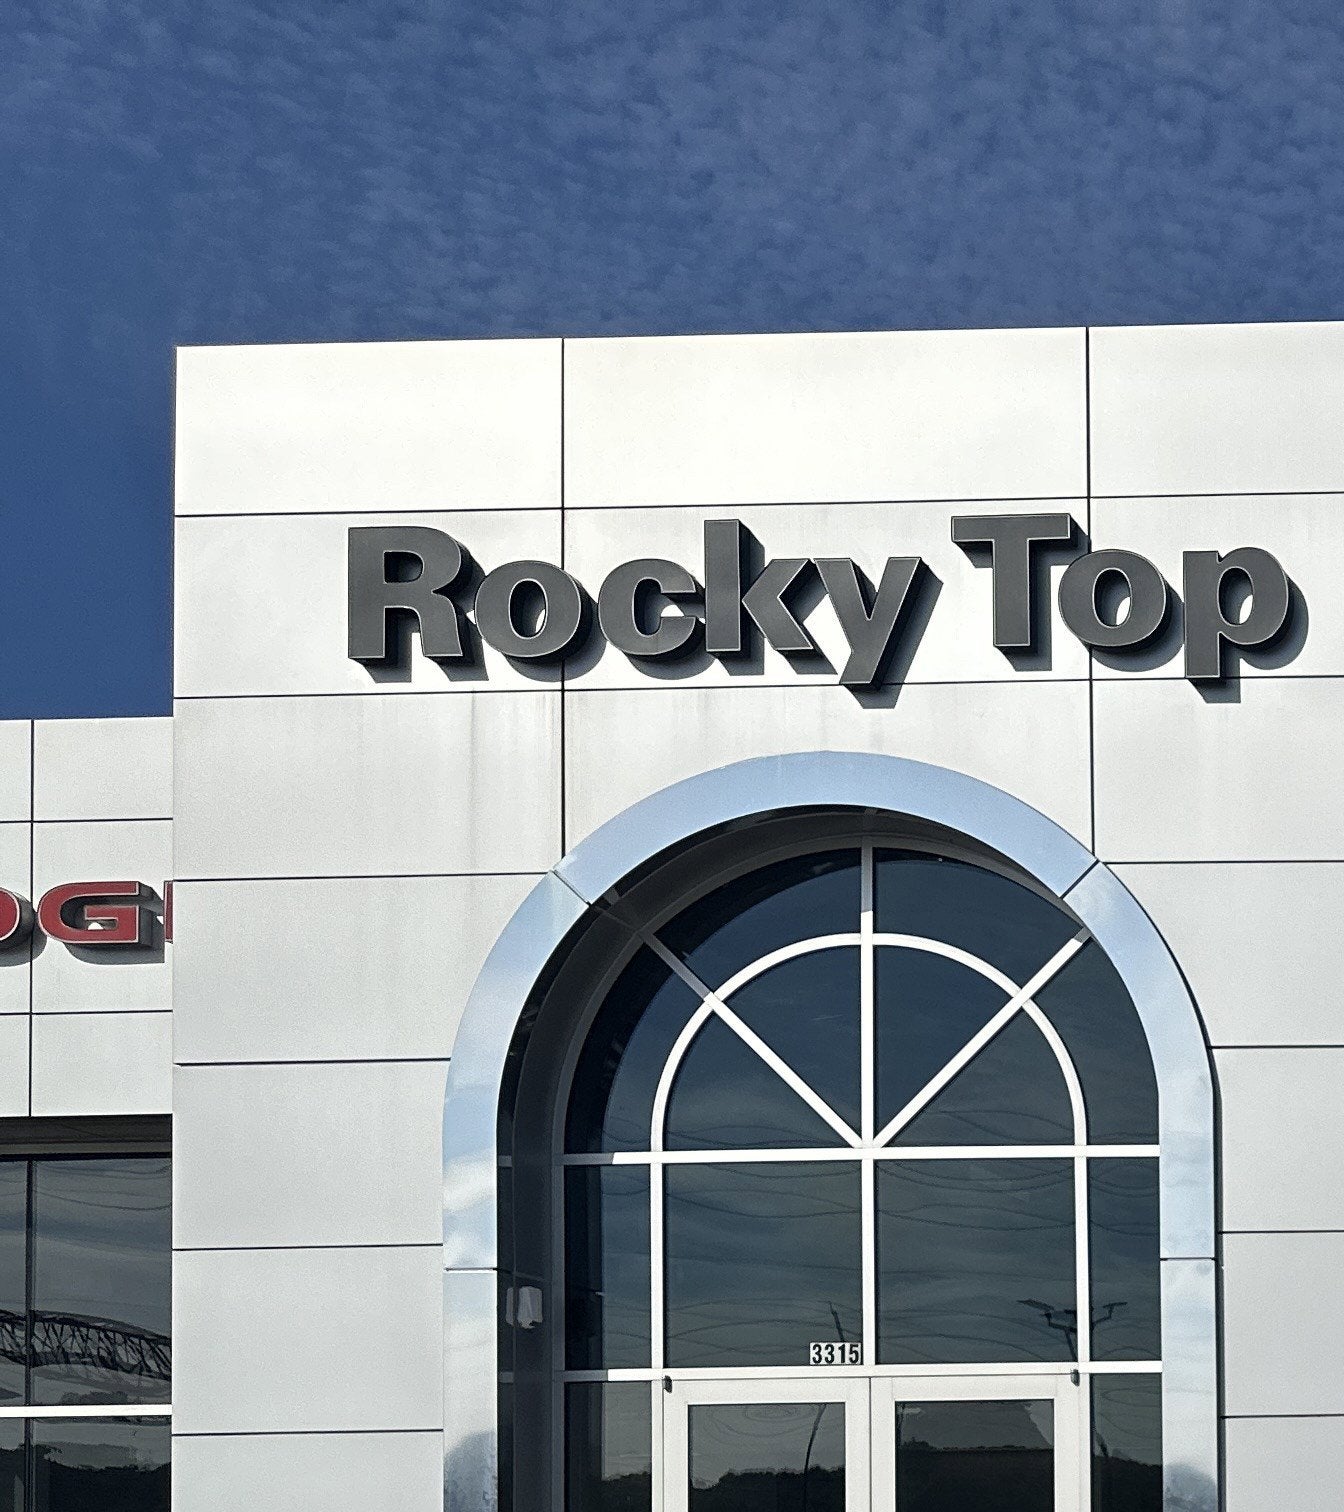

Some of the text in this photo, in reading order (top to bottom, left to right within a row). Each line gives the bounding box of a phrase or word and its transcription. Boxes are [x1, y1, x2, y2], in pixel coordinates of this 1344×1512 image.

[348, 513, 1290, 685] Rocky Top
[812, 1344, 859, 1364] 3315
